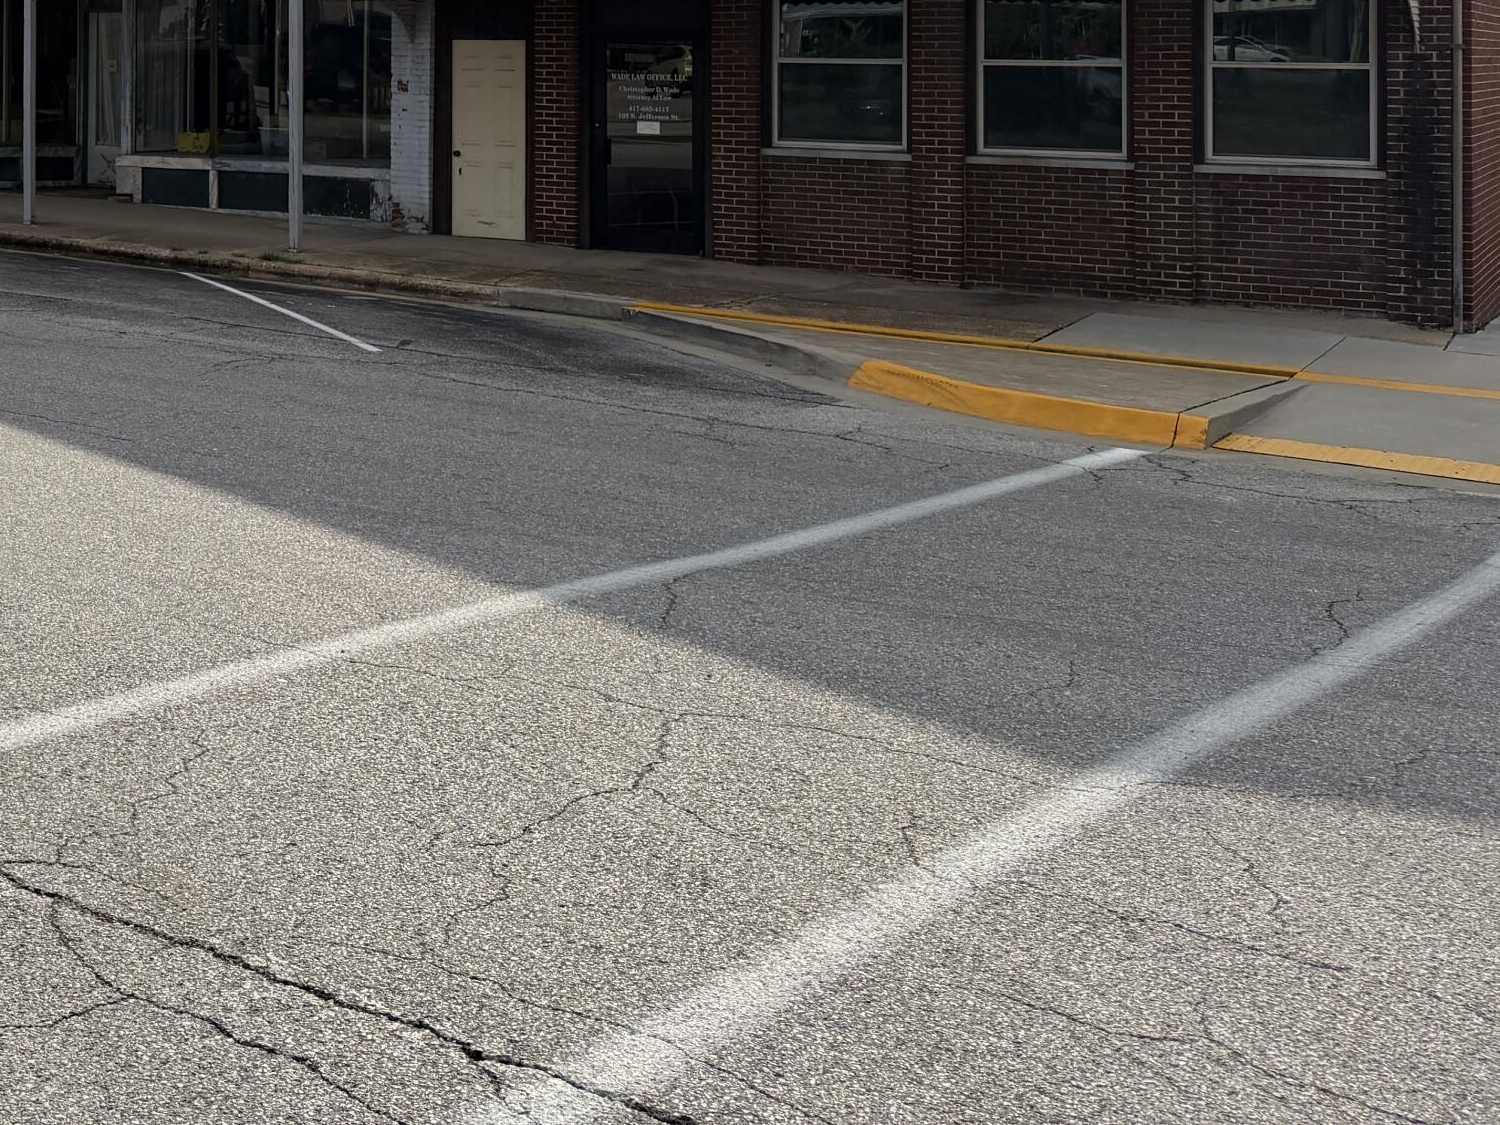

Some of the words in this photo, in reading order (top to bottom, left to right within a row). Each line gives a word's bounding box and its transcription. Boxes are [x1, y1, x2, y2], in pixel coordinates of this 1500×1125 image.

[611, 73, 629, 81] WADE
[631, 73, 646, 82] LAW
[674, 74, 688, 82] LLC
[618, 85, 655, 93] Christopher
